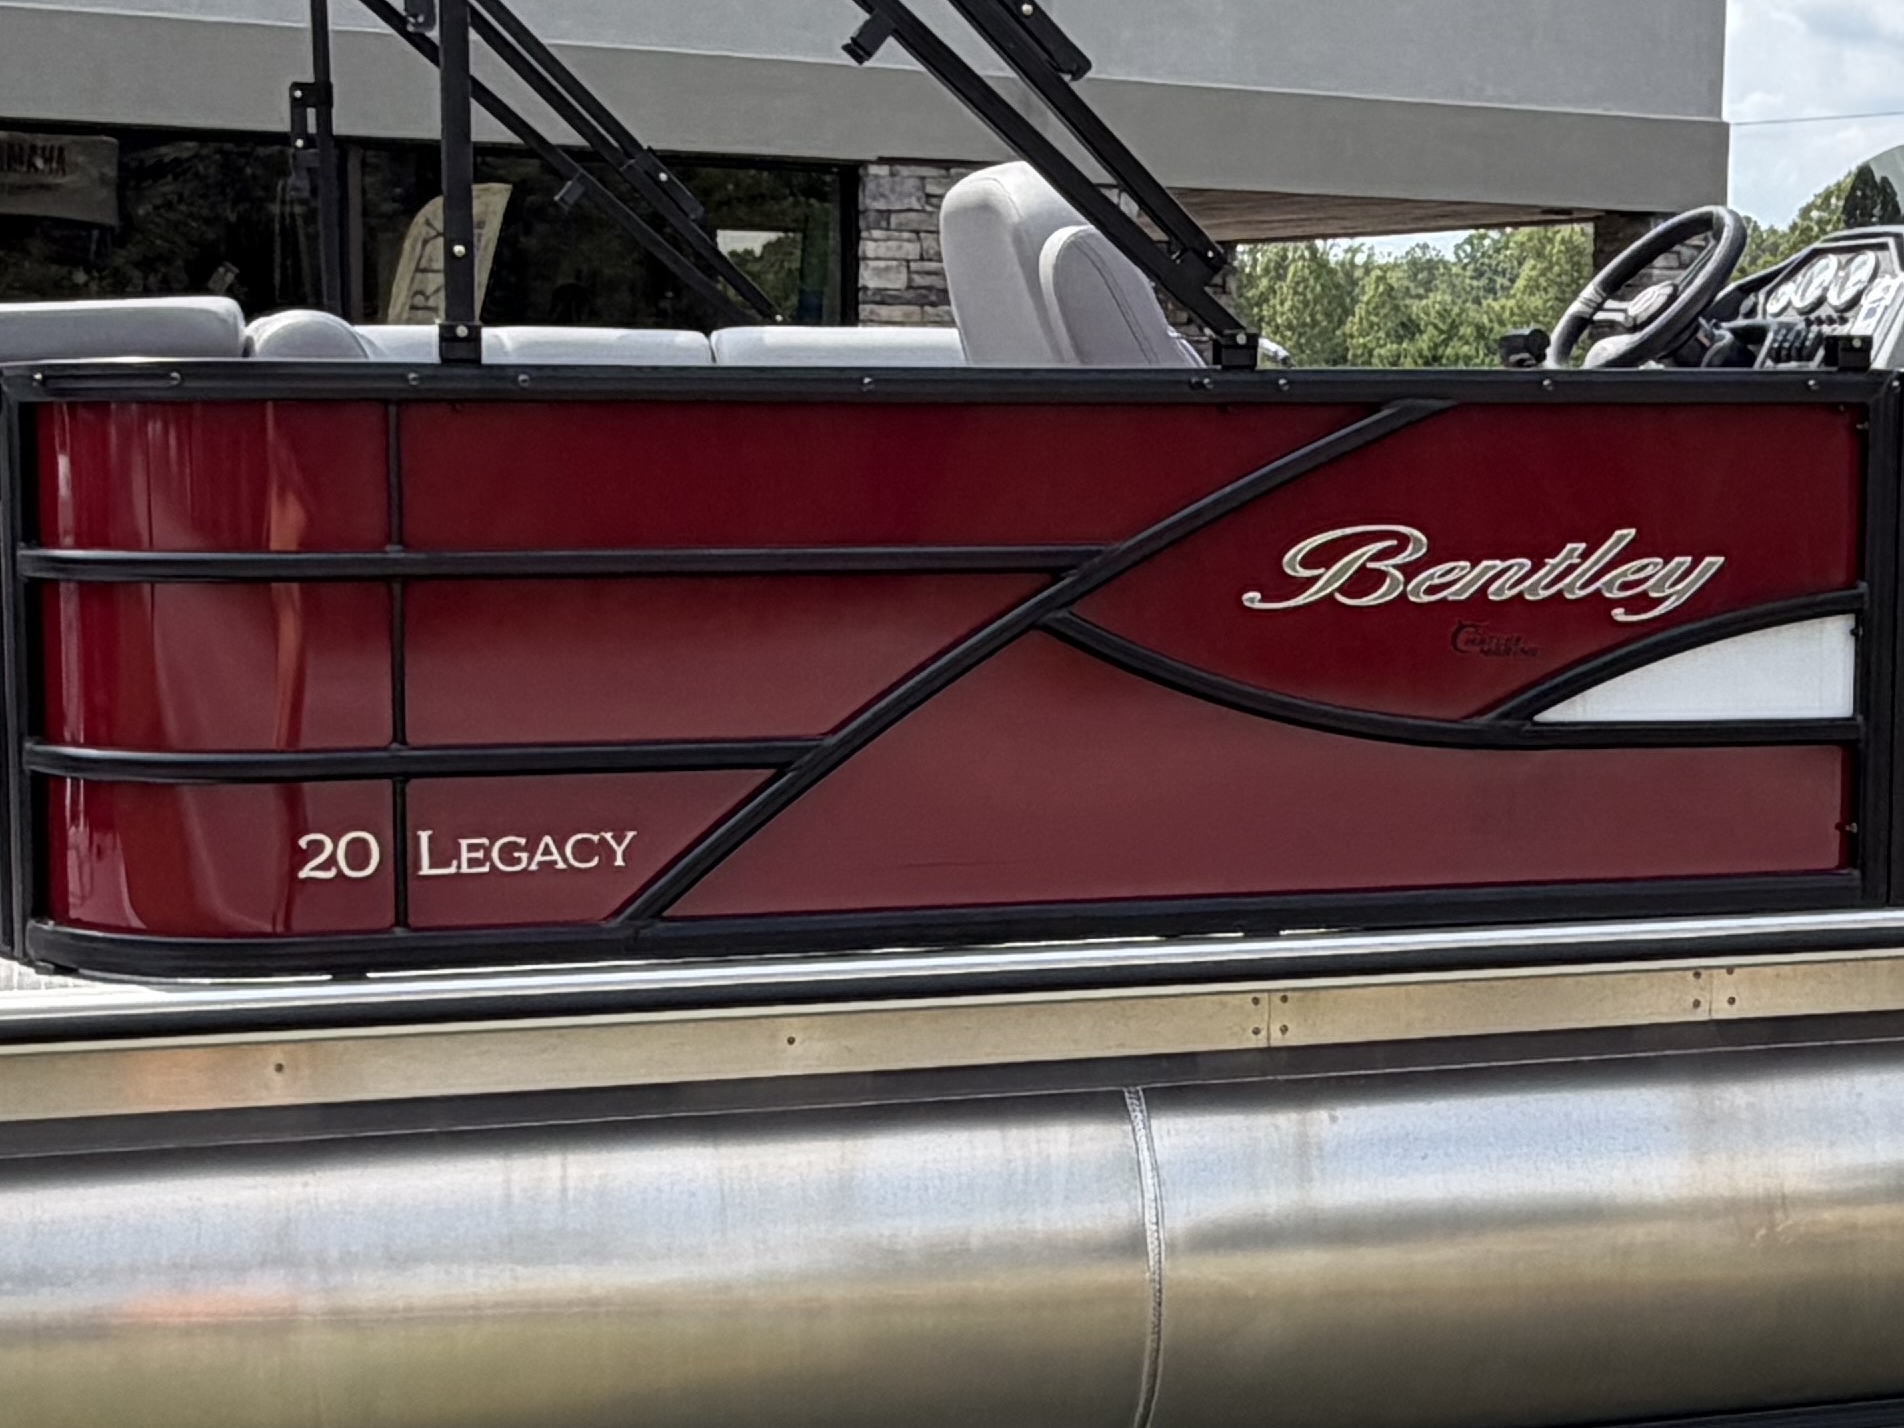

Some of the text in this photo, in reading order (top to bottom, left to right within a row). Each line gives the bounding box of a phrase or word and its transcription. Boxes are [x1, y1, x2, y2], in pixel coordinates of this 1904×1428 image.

[1242, 523, 1726, 622] Bentley
[298, 829, 638, 879] 20 LEGACY
